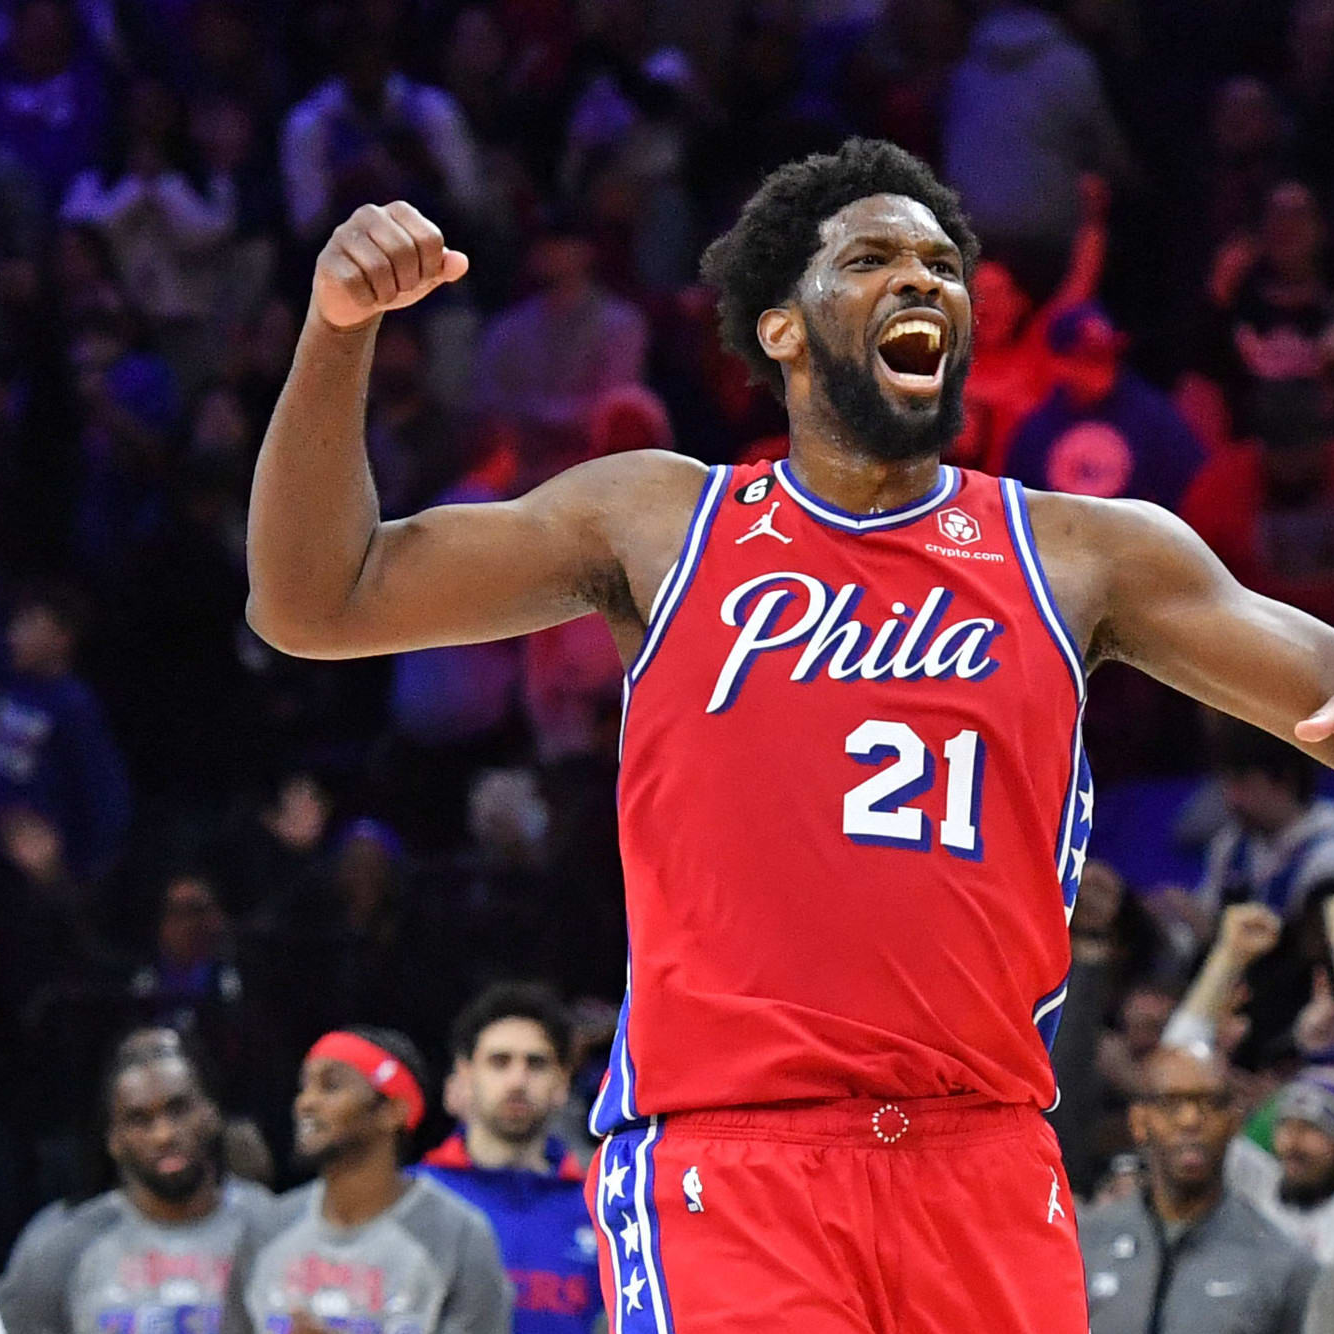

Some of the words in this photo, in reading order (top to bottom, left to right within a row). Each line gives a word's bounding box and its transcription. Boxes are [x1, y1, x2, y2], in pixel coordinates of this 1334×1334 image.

[744, 478, 768, 503] 6
[924, 543, 1005, 563] crypto.com
[706, 571, 1004, 718] Phila
[843, 719, 986, 862] 21
